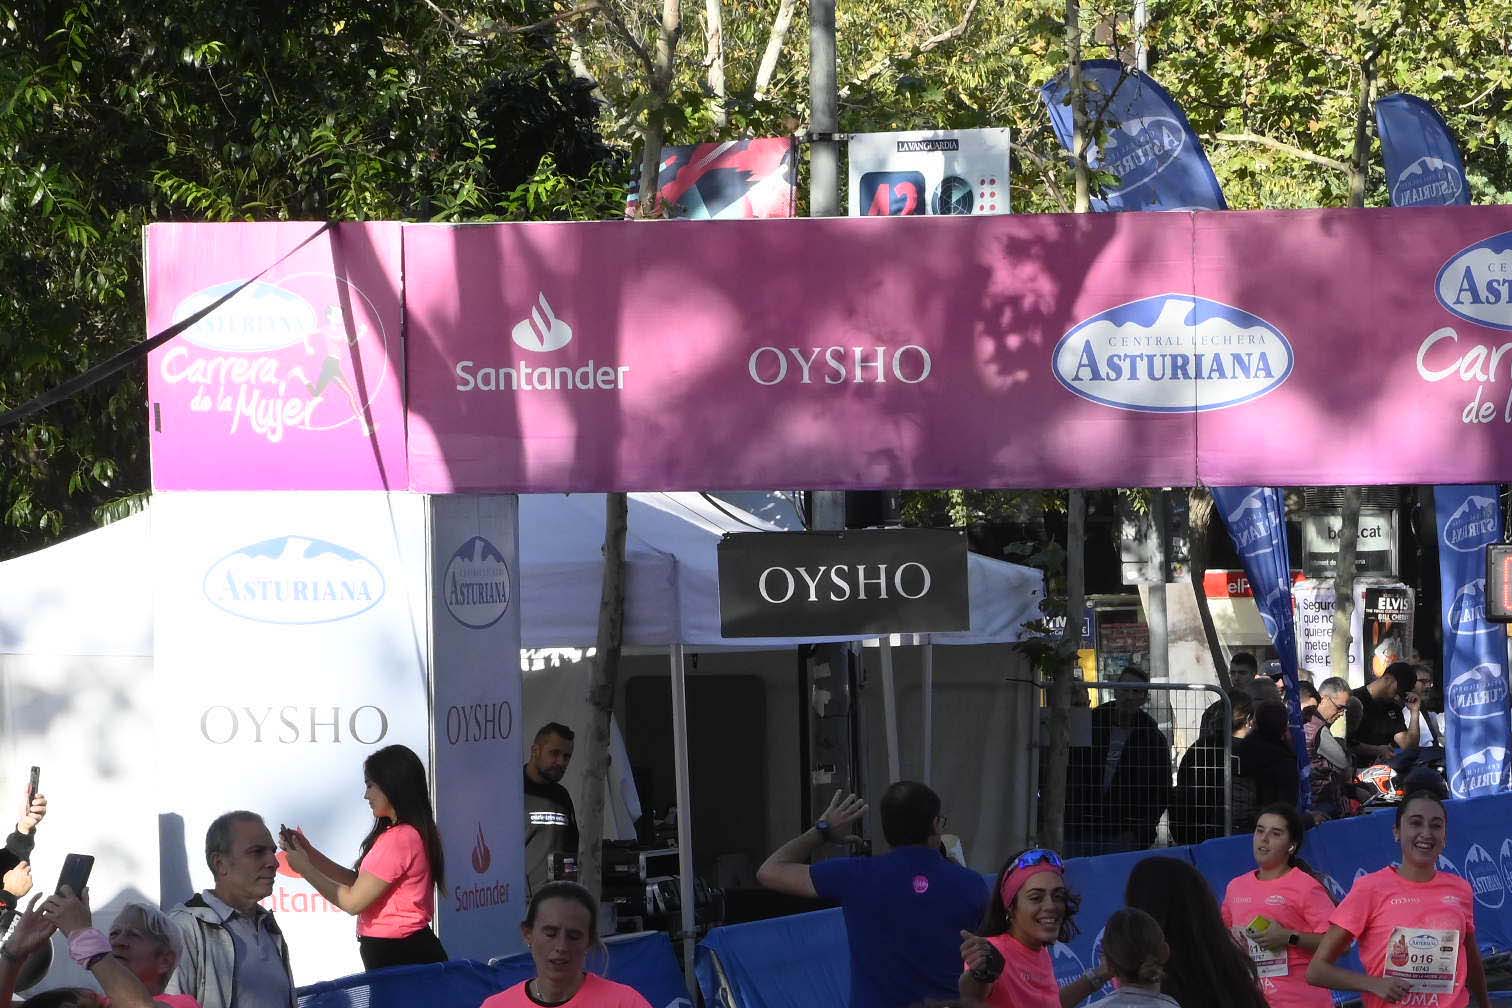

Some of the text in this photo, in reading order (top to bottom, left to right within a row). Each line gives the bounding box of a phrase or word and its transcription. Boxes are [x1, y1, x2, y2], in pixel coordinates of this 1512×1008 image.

[1108, 333, 1267, 348] CENTRAL LECHERA
[160, 346, 282, 385] Carrera
[455, 359, 631, 392] Santander
[748, 344, 932, 386] OYSHO
[1071, 338, 1275, 382] ASTURIANA
[230, 382, 324, 443] Mujer
[1461, 384, 1496, 424] de
[218, 568, 373, 602] ASTURIANA
[448, 571, 507, 606] ASTURIANA
[758, 561, 931, 605] OYSHO
[1377, 596, 1408, 610] ELVIS
[1304, 614, 1320, 627] que
[1304, 627, 1335, 639] quiere
[1305, 653, 1324, 664] este
[200, 704, 389, 745] OYSHO
[446, 700, 512, 745] OYSHO
[454, 879, 510, 913] Santander
[1410, 954, 1434, 964] 016
